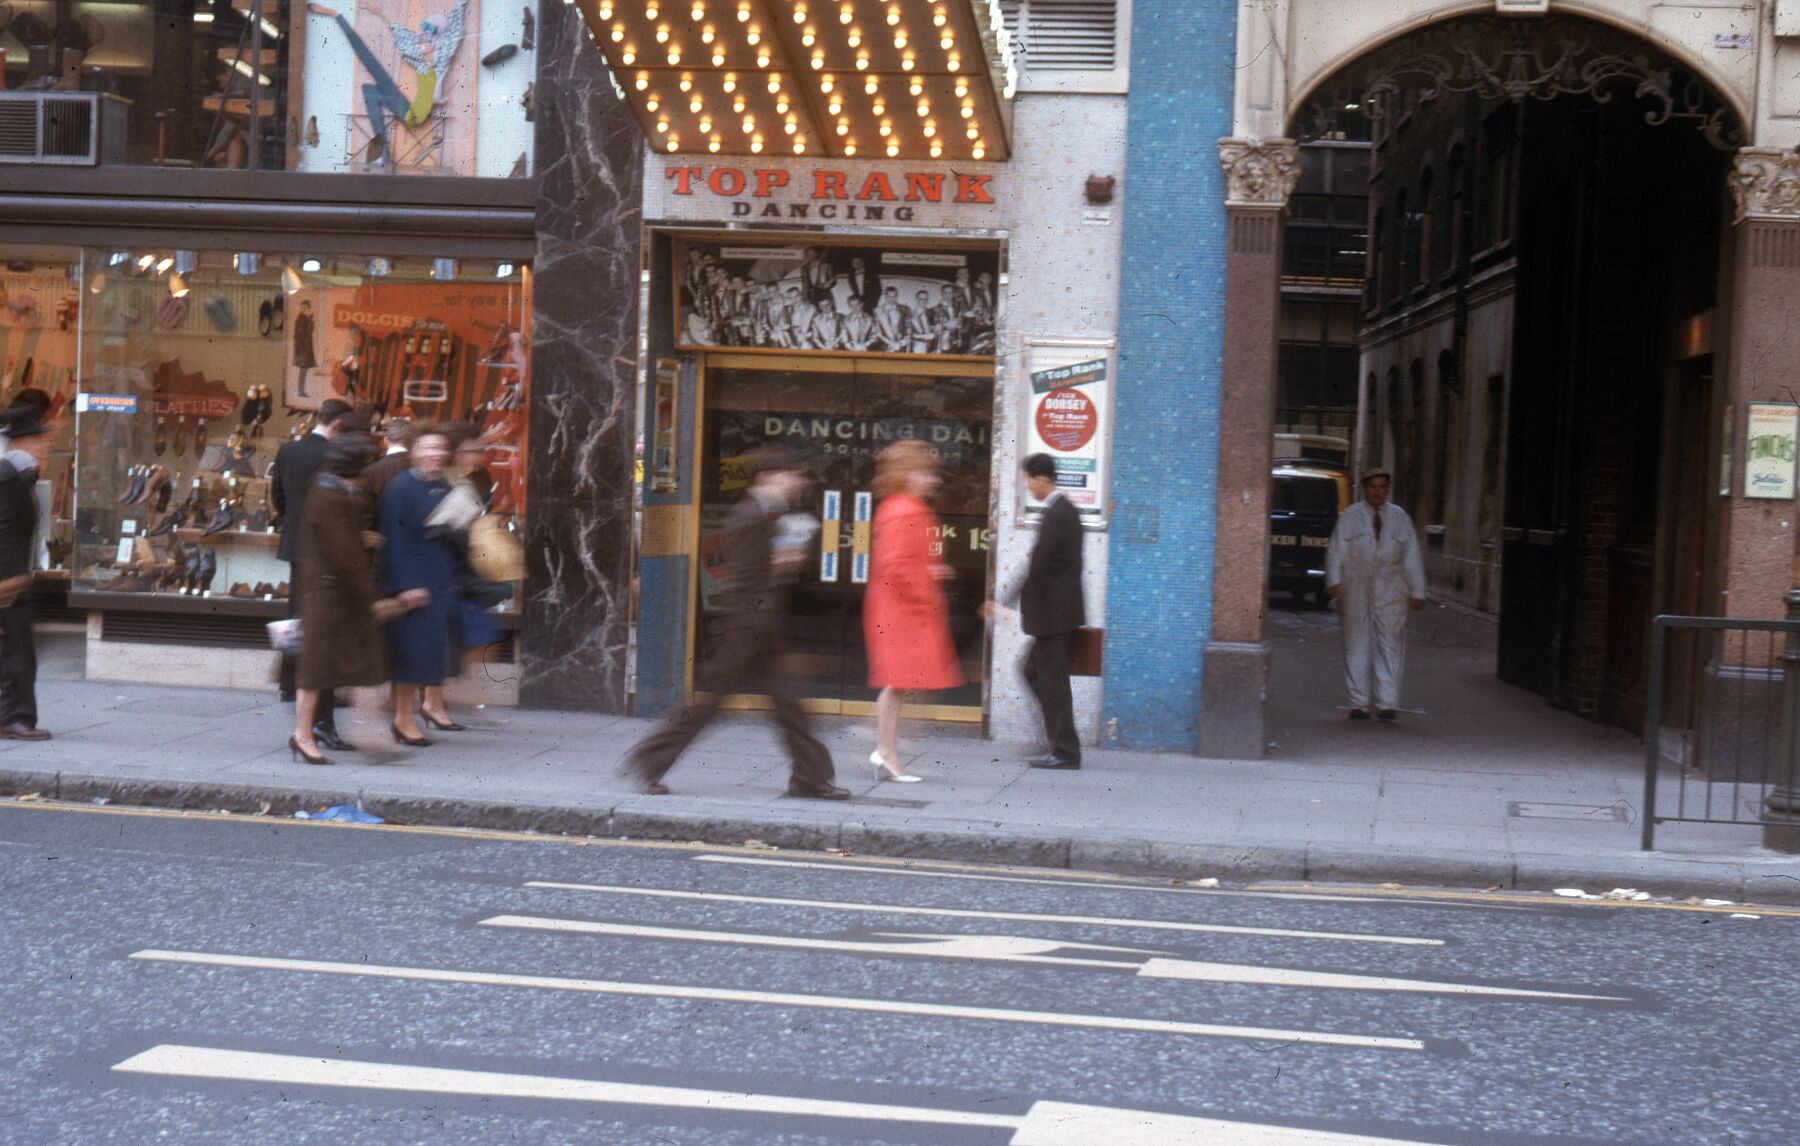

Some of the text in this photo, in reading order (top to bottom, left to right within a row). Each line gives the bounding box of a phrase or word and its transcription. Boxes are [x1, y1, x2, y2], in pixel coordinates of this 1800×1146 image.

[665, 166, 995, 204] TOP RANK
[731, 201, 915, 221] DANCING
[337, 310, 414, 328] DOLCIS
[1046, 368, 1071, 381] Top
[1071, 361, 1105, 376] Rank
[1045, 398, 1088, 411] DORSEY
[764, 417, 915, 440] DANCING
